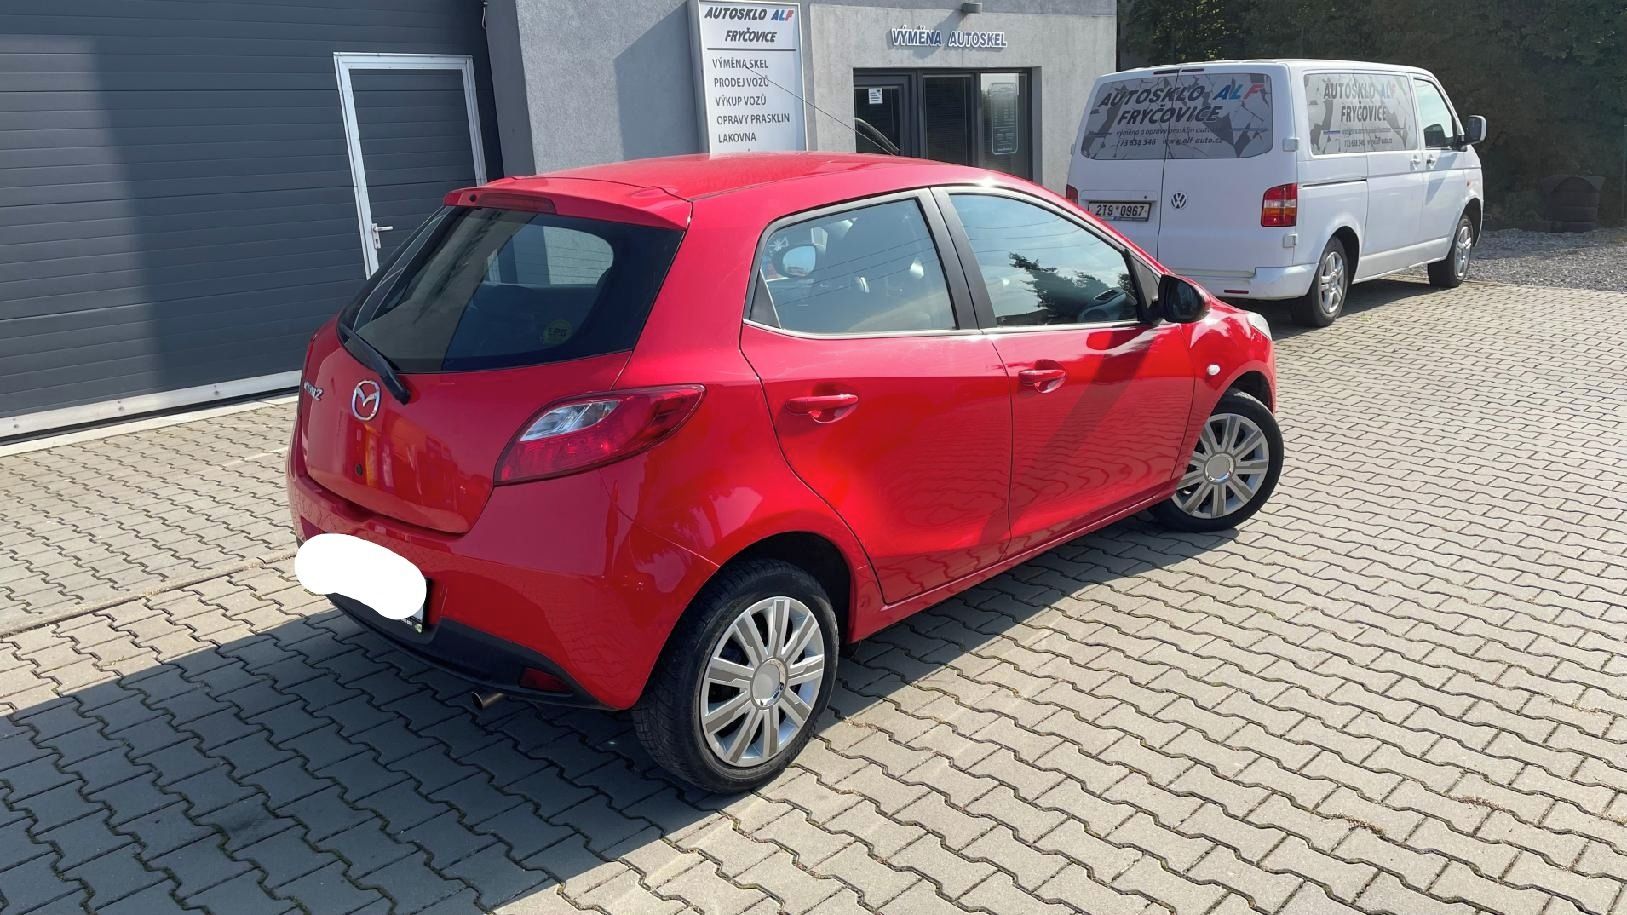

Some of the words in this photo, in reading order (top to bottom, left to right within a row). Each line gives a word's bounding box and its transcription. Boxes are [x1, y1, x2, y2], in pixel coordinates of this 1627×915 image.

[704, 7, 767, 20] AUTOSKLO
[771, 9, 794, 21] ALF
[725, 27, 777, 42] FRYČOVICE
[892, 25, 942, 46] VÝMĚNA
[948, 31, 1007, 48] AUTOSKEL
[712, 57, 746, 69] VÝMĚNA
[749, 59, 769, 69] SKEL
[714, 77, 745, 88] PRODEJ
[716, 94, 742, 107] VÝKUP
[1098, 86, 1204, 107] AUTOSKLO
[1213, 83, 1264, 101] ALF
[750, 113, 790, 124] PRASKLIN
[1117, 104, 1222, 125] FRYČOVICE
[718, 132, 757, 143] LAKOVNA
[1120, 205, 1144, 217] 0967
